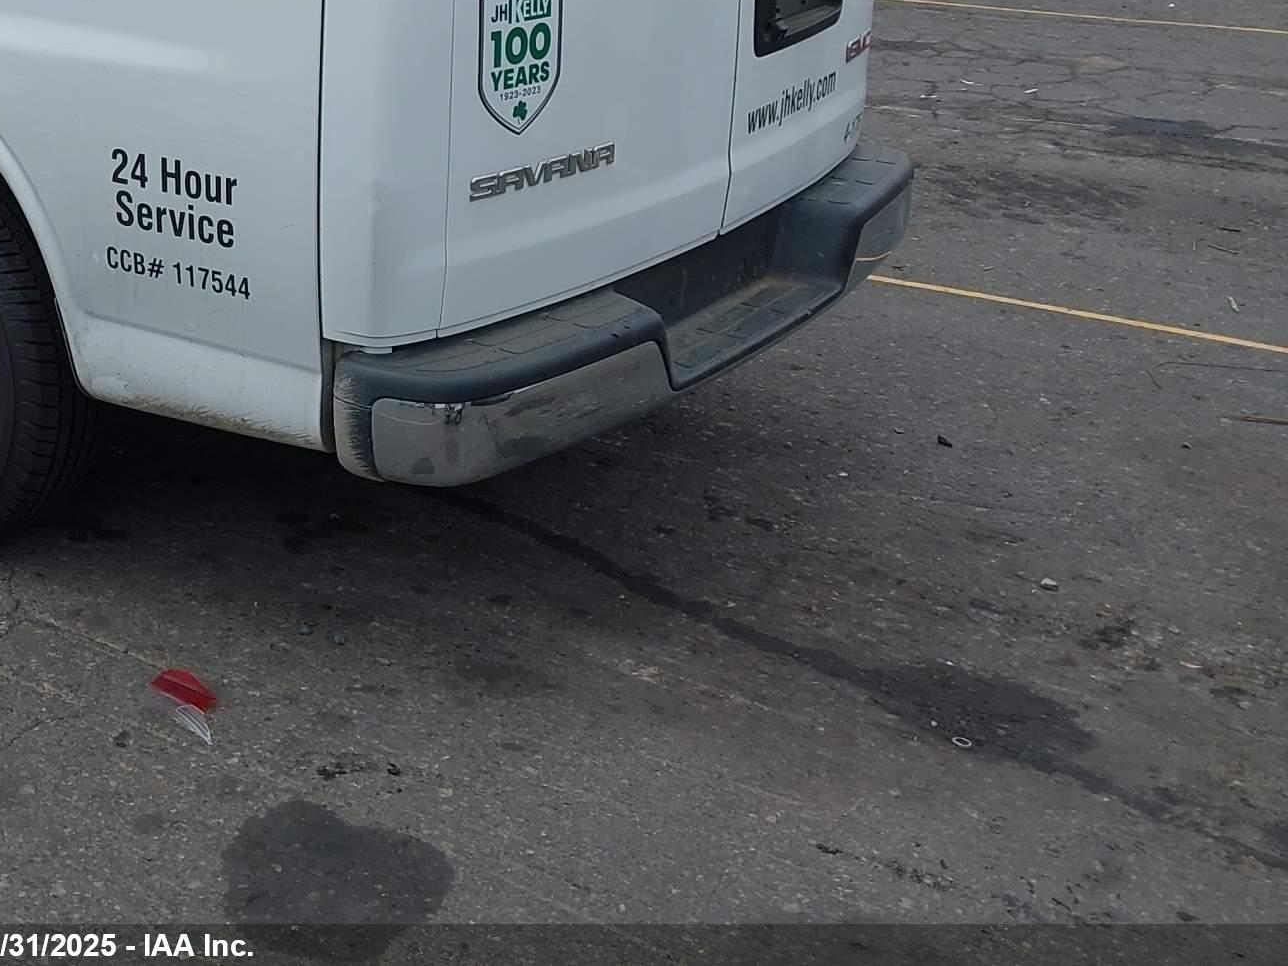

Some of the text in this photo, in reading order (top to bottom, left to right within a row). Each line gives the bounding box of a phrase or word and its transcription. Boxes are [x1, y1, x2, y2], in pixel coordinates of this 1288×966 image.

[490, 22, 552, 69] 100
[490, 60, 551, 92] YEARS
[499, 85, 542, 102] 1923-2023
[747, 70, 837, 135] www.jhkelly.com
[111, 148, 238, 206] 24 Hour
[469, 141, 616, 203] SAVANA
[115, 189, 235, 248] Service
[106, 245, 251, 300] CCB# 117544
